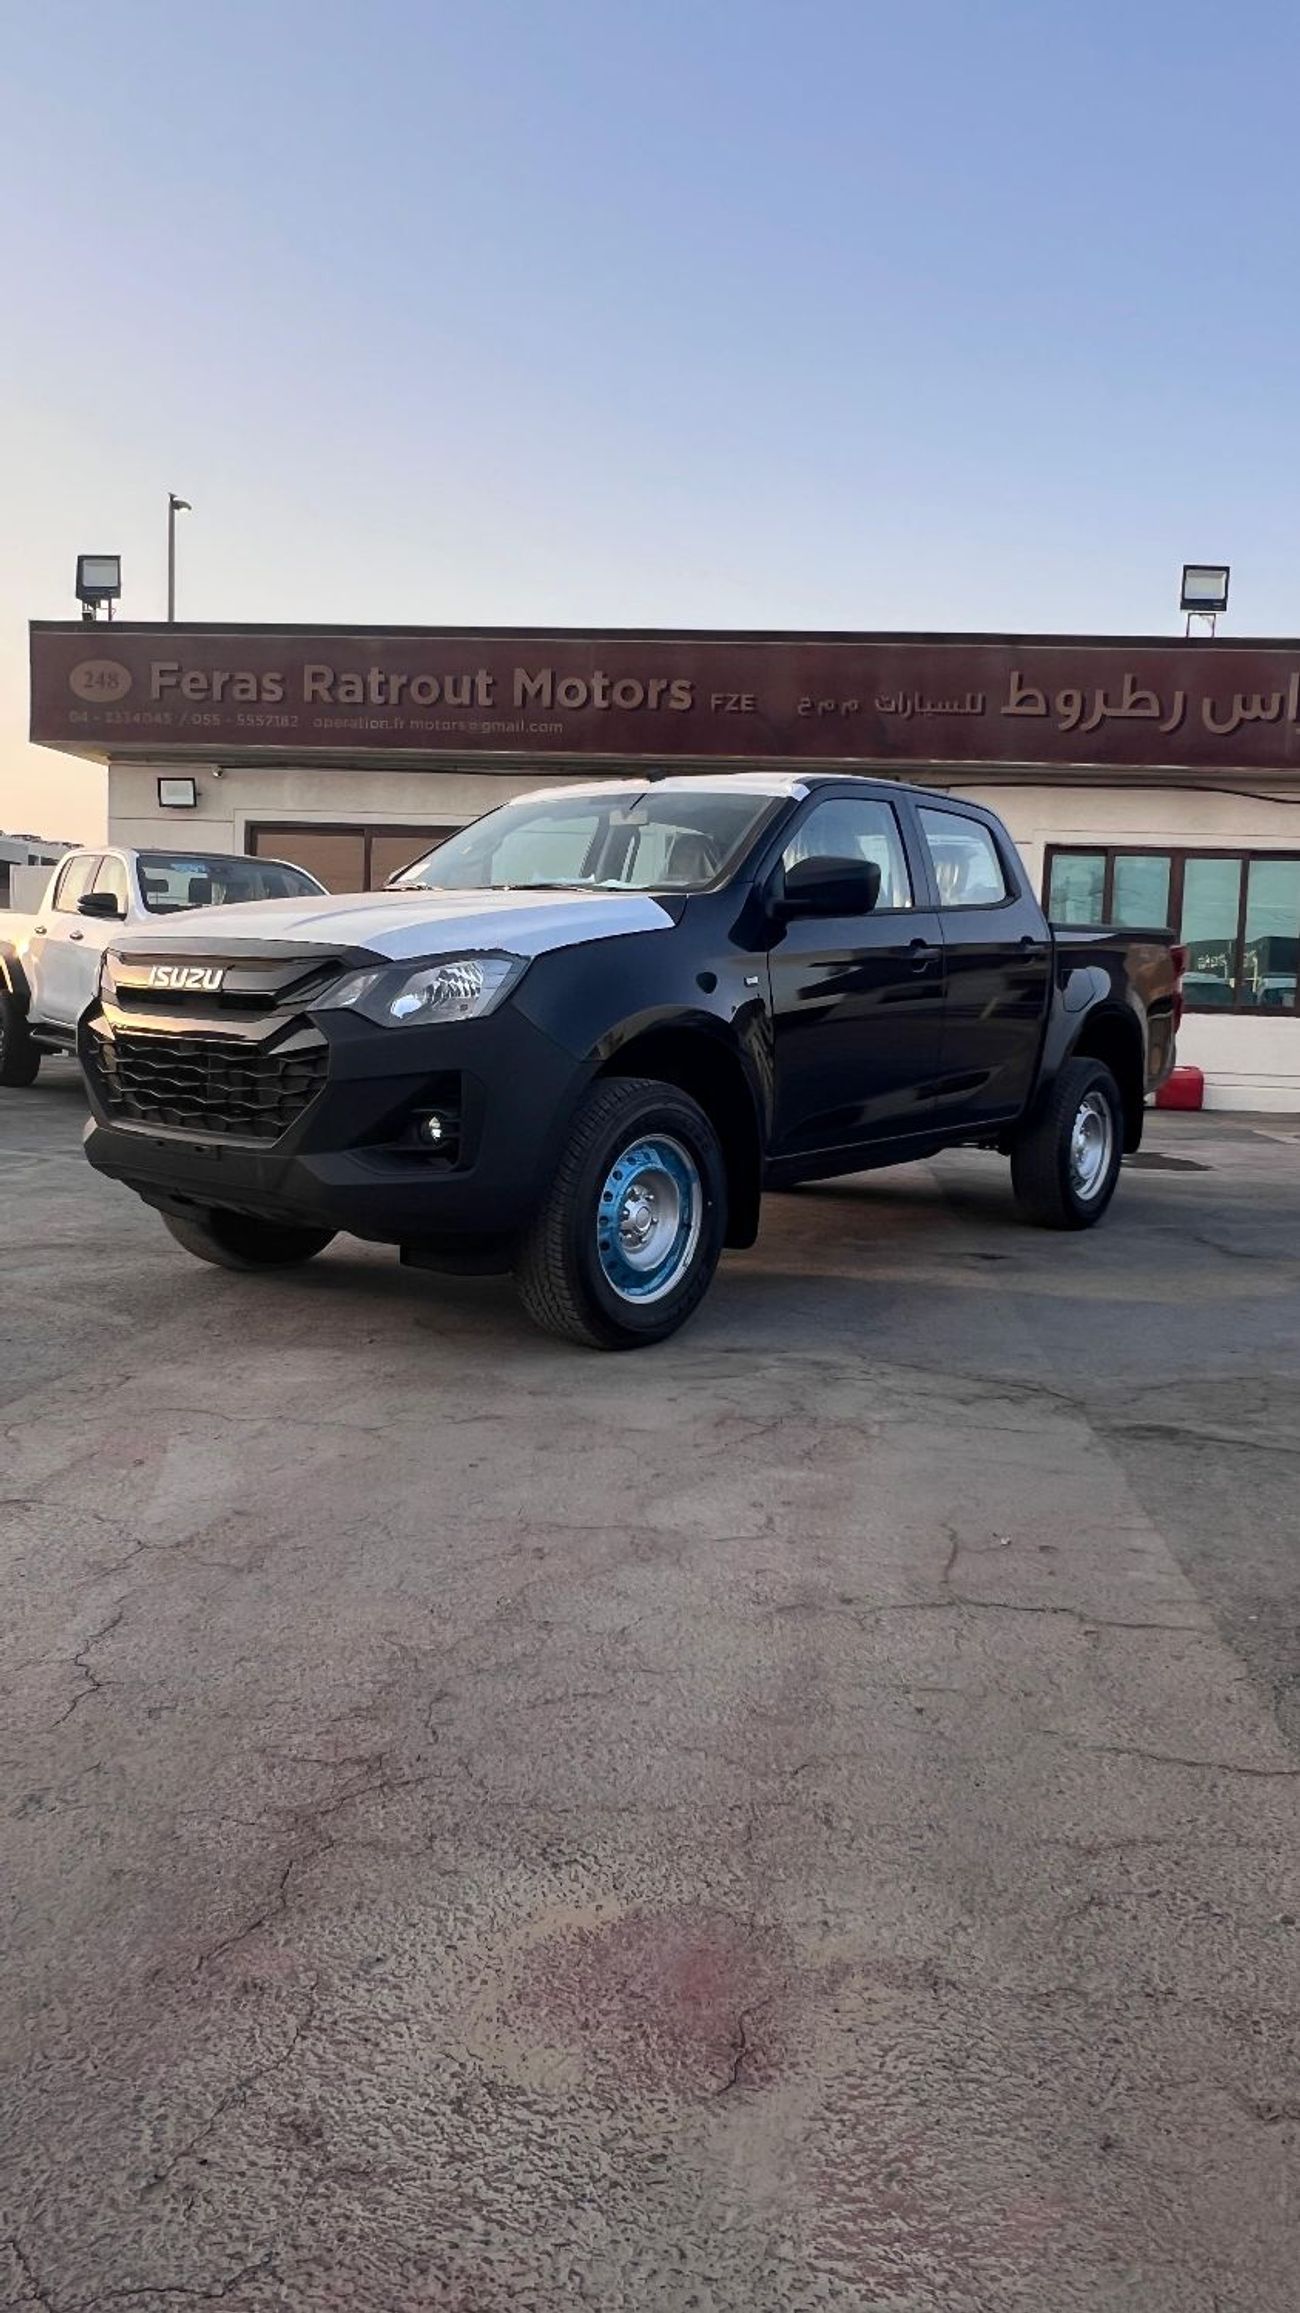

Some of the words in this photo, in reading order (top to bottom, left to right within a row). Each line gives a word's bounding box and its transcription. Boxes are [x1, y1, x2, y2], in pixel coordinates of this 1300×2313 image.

[84, 670, 120, 689] 248
[149, 661, 286, 704] Feras
[303, 664, 494, 708] Ratrout
[513, 667, 693, 711] Motors
[711, 693, 757, 713] FZE
[874, 690, 984, 720] للسيارات
[1000, 670, 1186, 732] رطروط
[1202, 672, 1300, 734] اس
[149, 966, 223, 990] ISUZU
